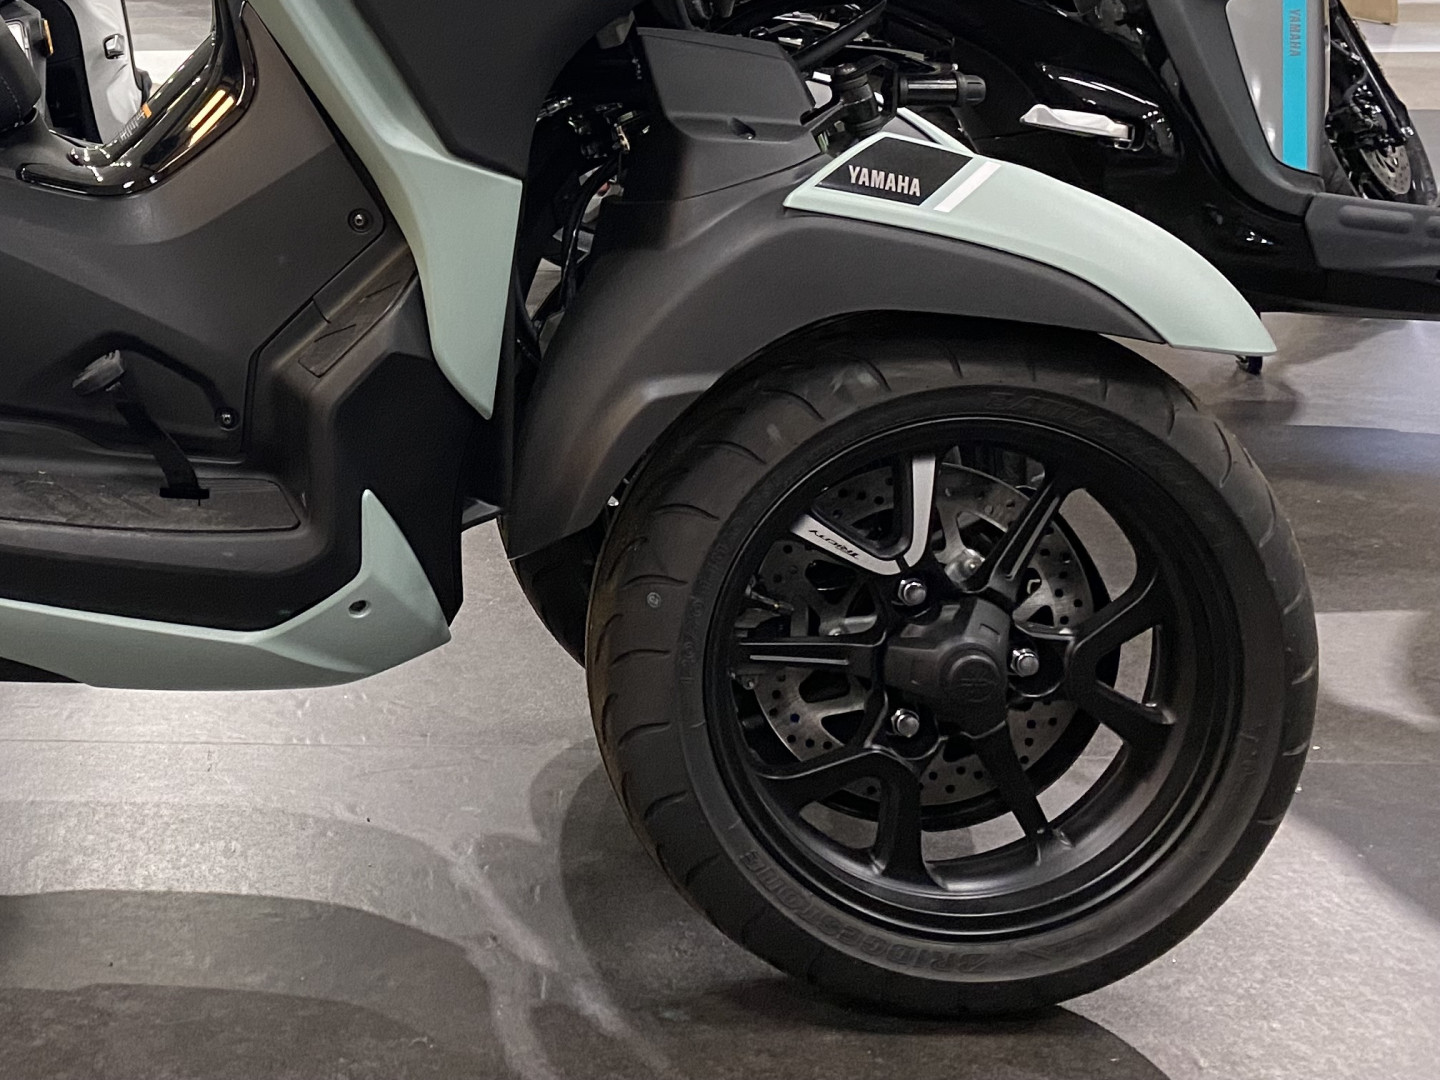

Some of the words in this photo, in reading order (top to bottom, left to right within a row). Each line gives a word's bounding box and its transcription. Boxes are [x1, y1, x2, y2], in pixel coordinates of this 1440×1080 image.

[1289, 8, 1302, 57] YAMAHA
[848, 164, 921, 197] YAMAHA
[808, 529, 859, 560] TRICITY
[739, 849, 991, 974] BRIDGESTONE
